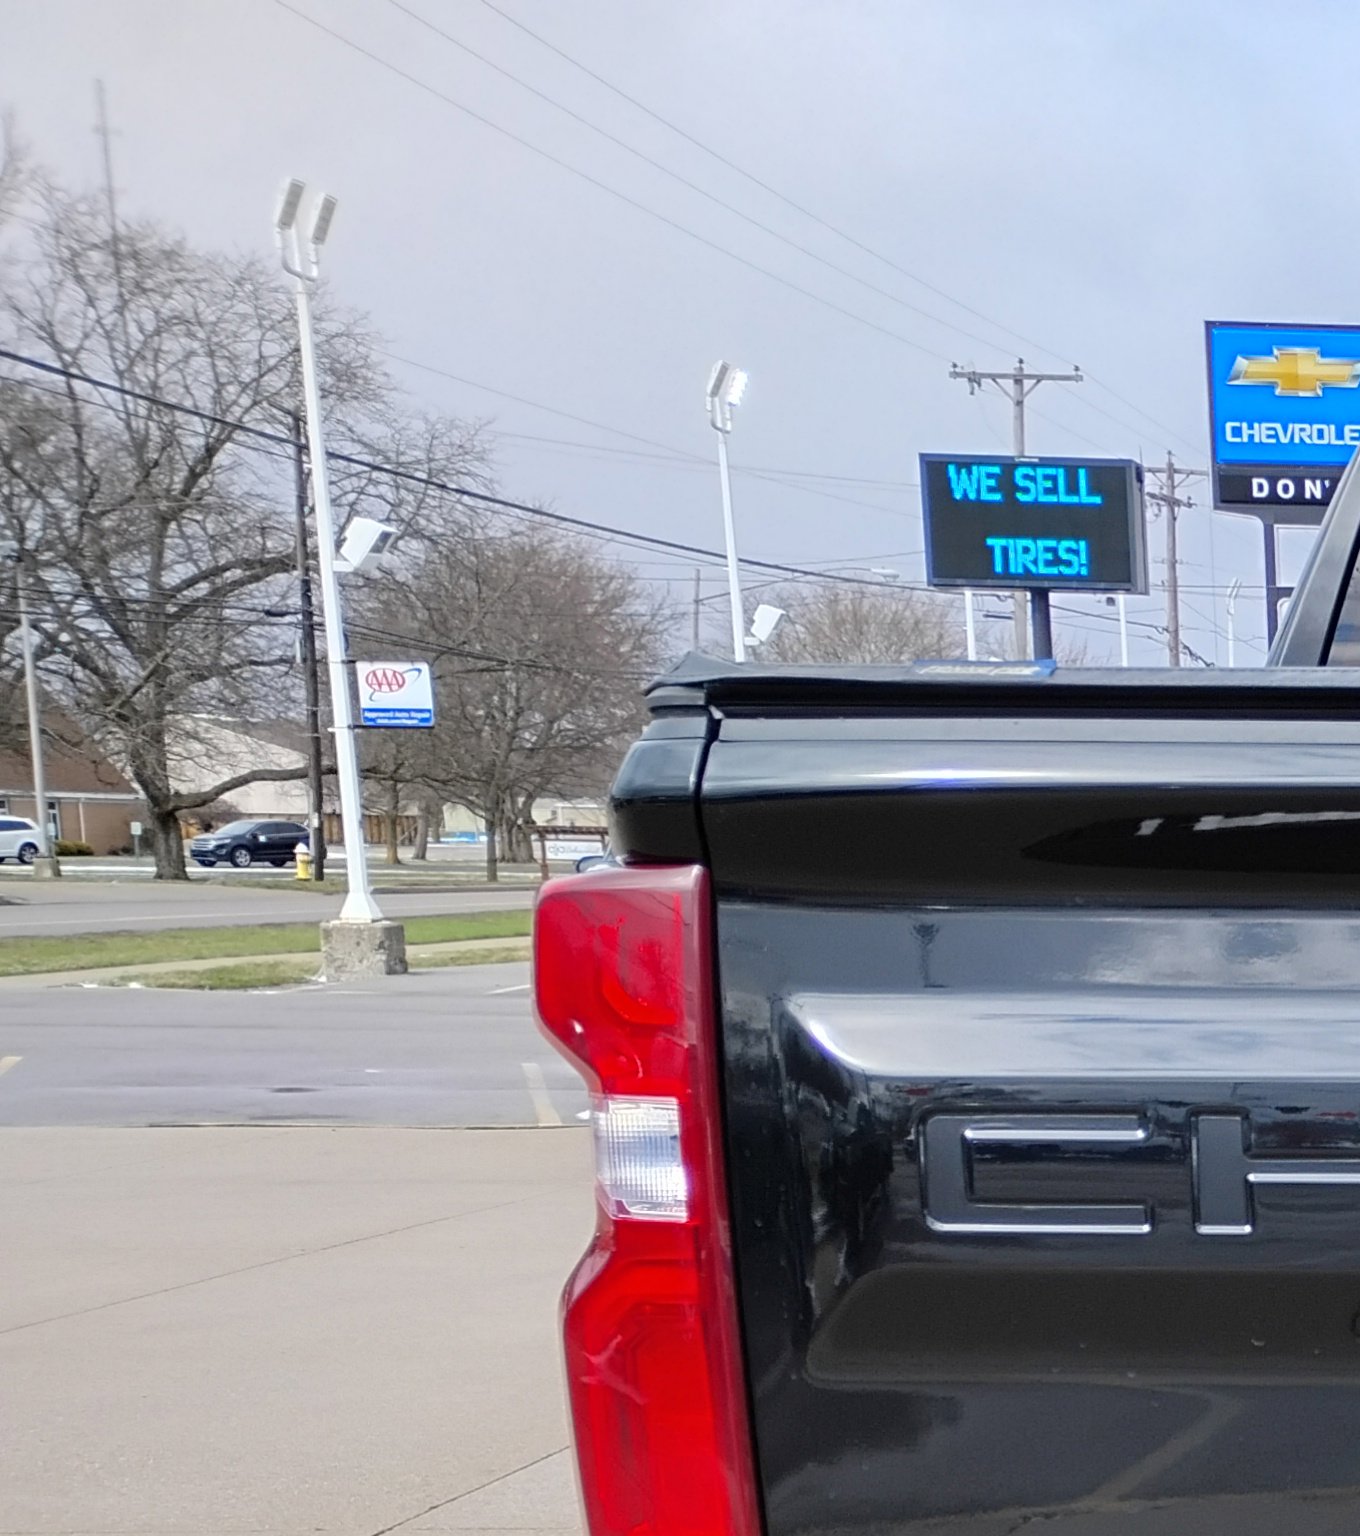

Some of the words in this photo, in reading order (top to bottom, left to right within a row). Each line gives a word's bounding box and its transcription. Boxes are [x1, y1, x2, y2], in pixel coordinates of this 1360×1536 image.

[948, 464, 1001, 501] WE
[1014, 466, 1102, 504] SELL
[1251, 478, 1330, 500] DON'
[986, 537, 1088, 576] TIRES!
[368, 669, 402, 692] AAA
